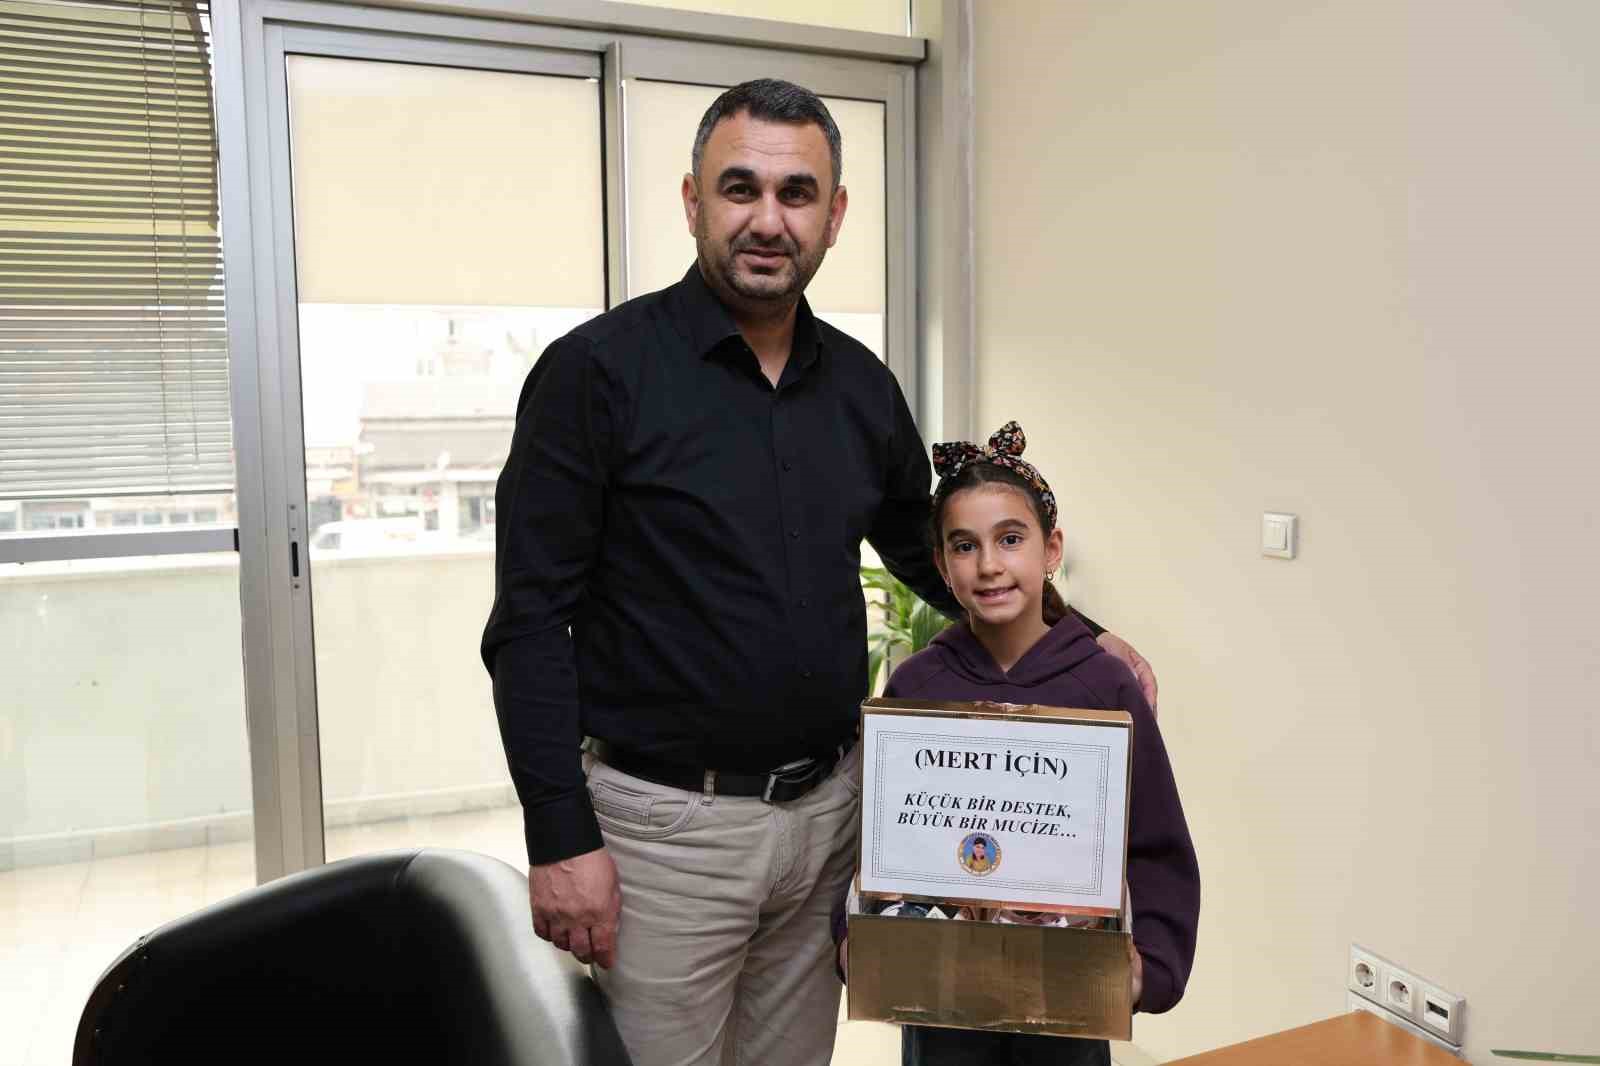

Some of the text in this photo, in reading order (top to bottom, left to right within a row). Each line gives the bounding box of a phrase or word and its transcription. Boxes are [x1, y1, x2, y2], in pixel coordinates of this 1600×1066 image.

[915, 749, 1068, 779] (MERT İÇİN)
[904, 792, 1071, 818] KÜÇÜK BİR DESTEK,
[897, 810, 954, 828] BÜYÜK
[959, 816, 987, 831] BİR
